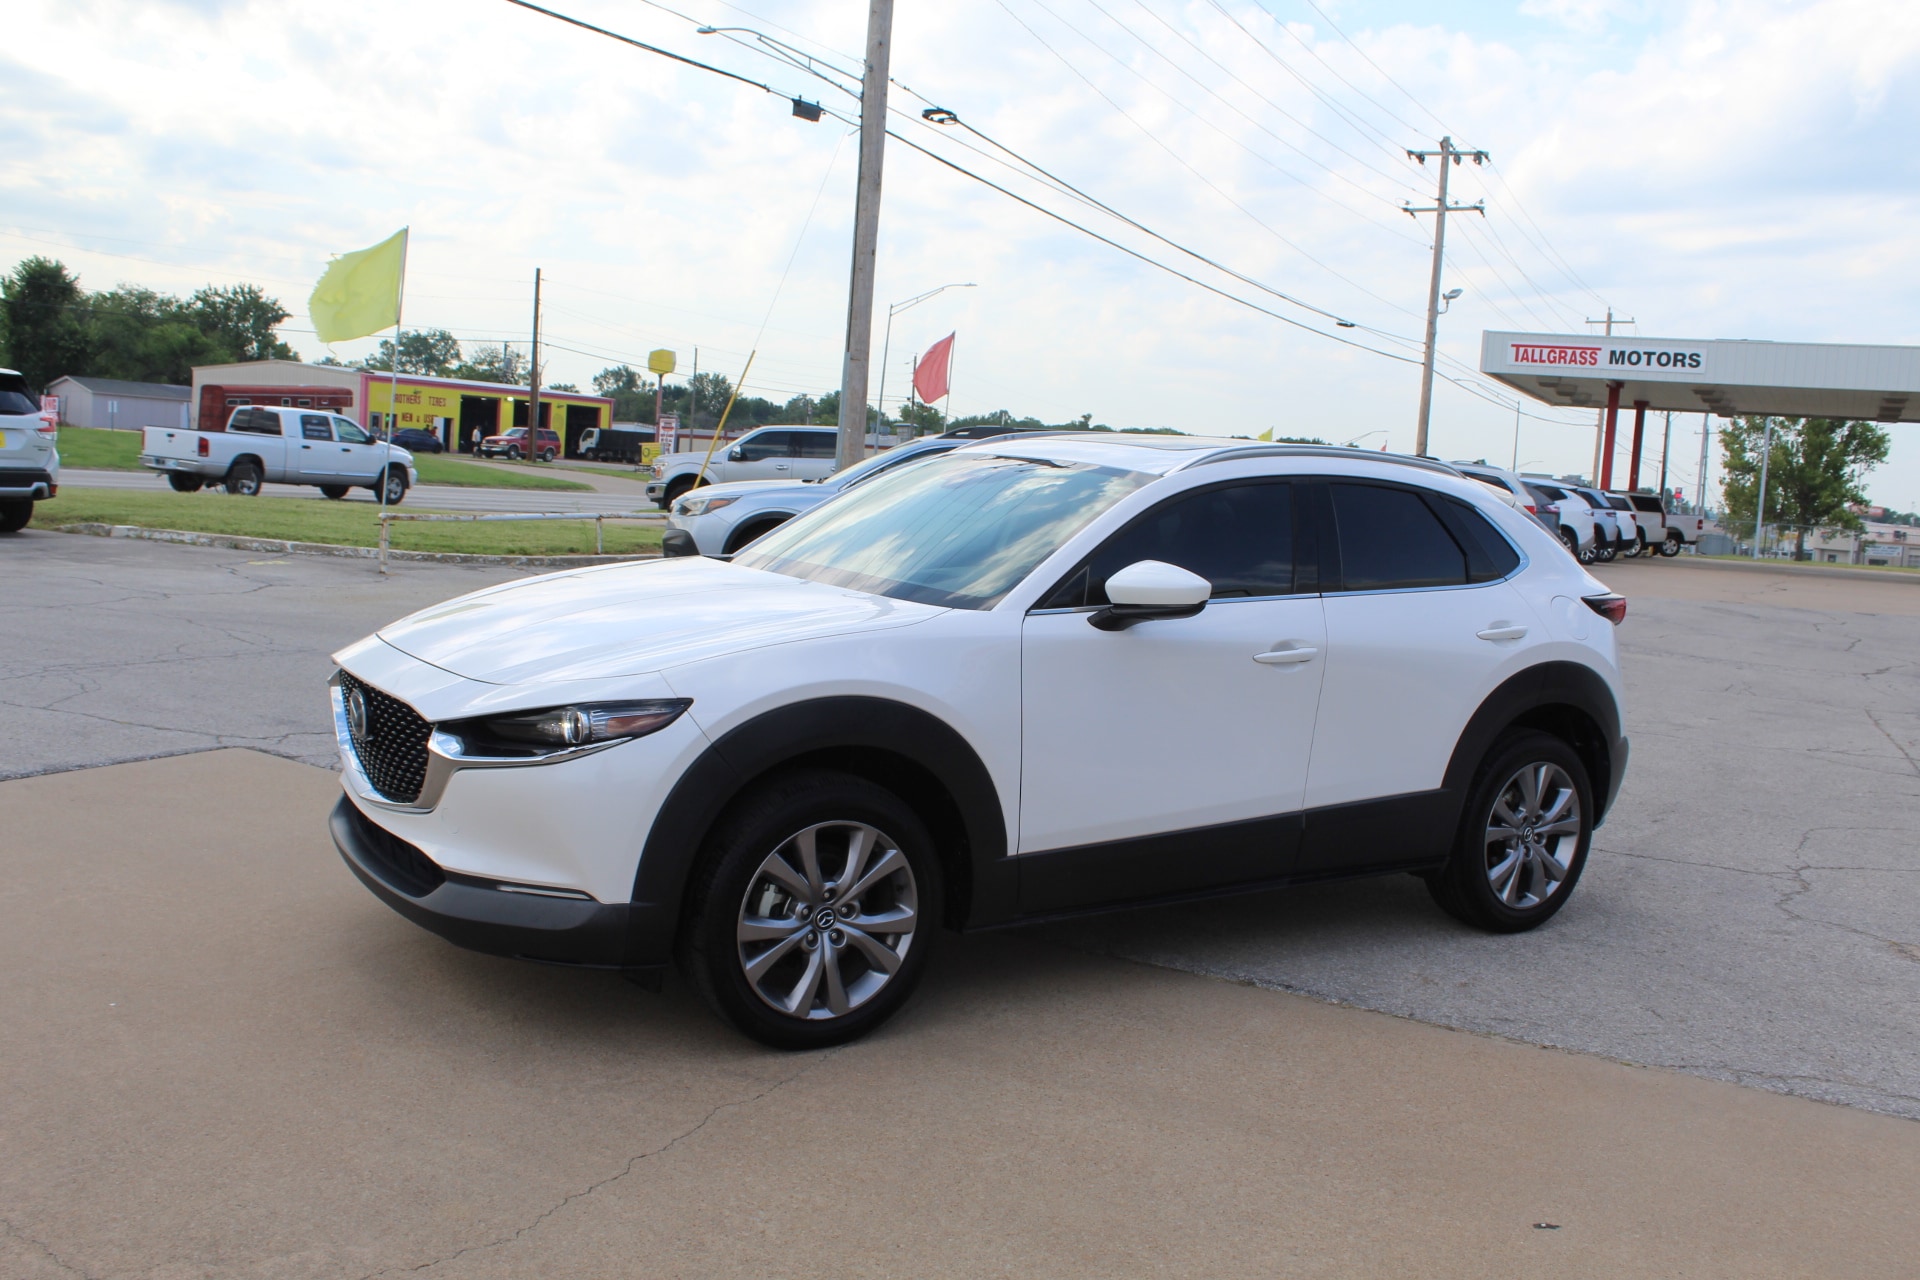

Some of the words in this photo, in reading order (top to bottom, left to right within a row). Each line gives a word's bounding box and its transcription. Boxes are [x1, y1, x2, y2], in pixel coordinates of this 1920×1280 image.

[1511, 343, 1602, 366] TALLGRASS
[1608, 349, 1702, 369] MOTORS
[391, 394, 421, 404] ROTHERS
[429, 396, 446, 406] TIRES
